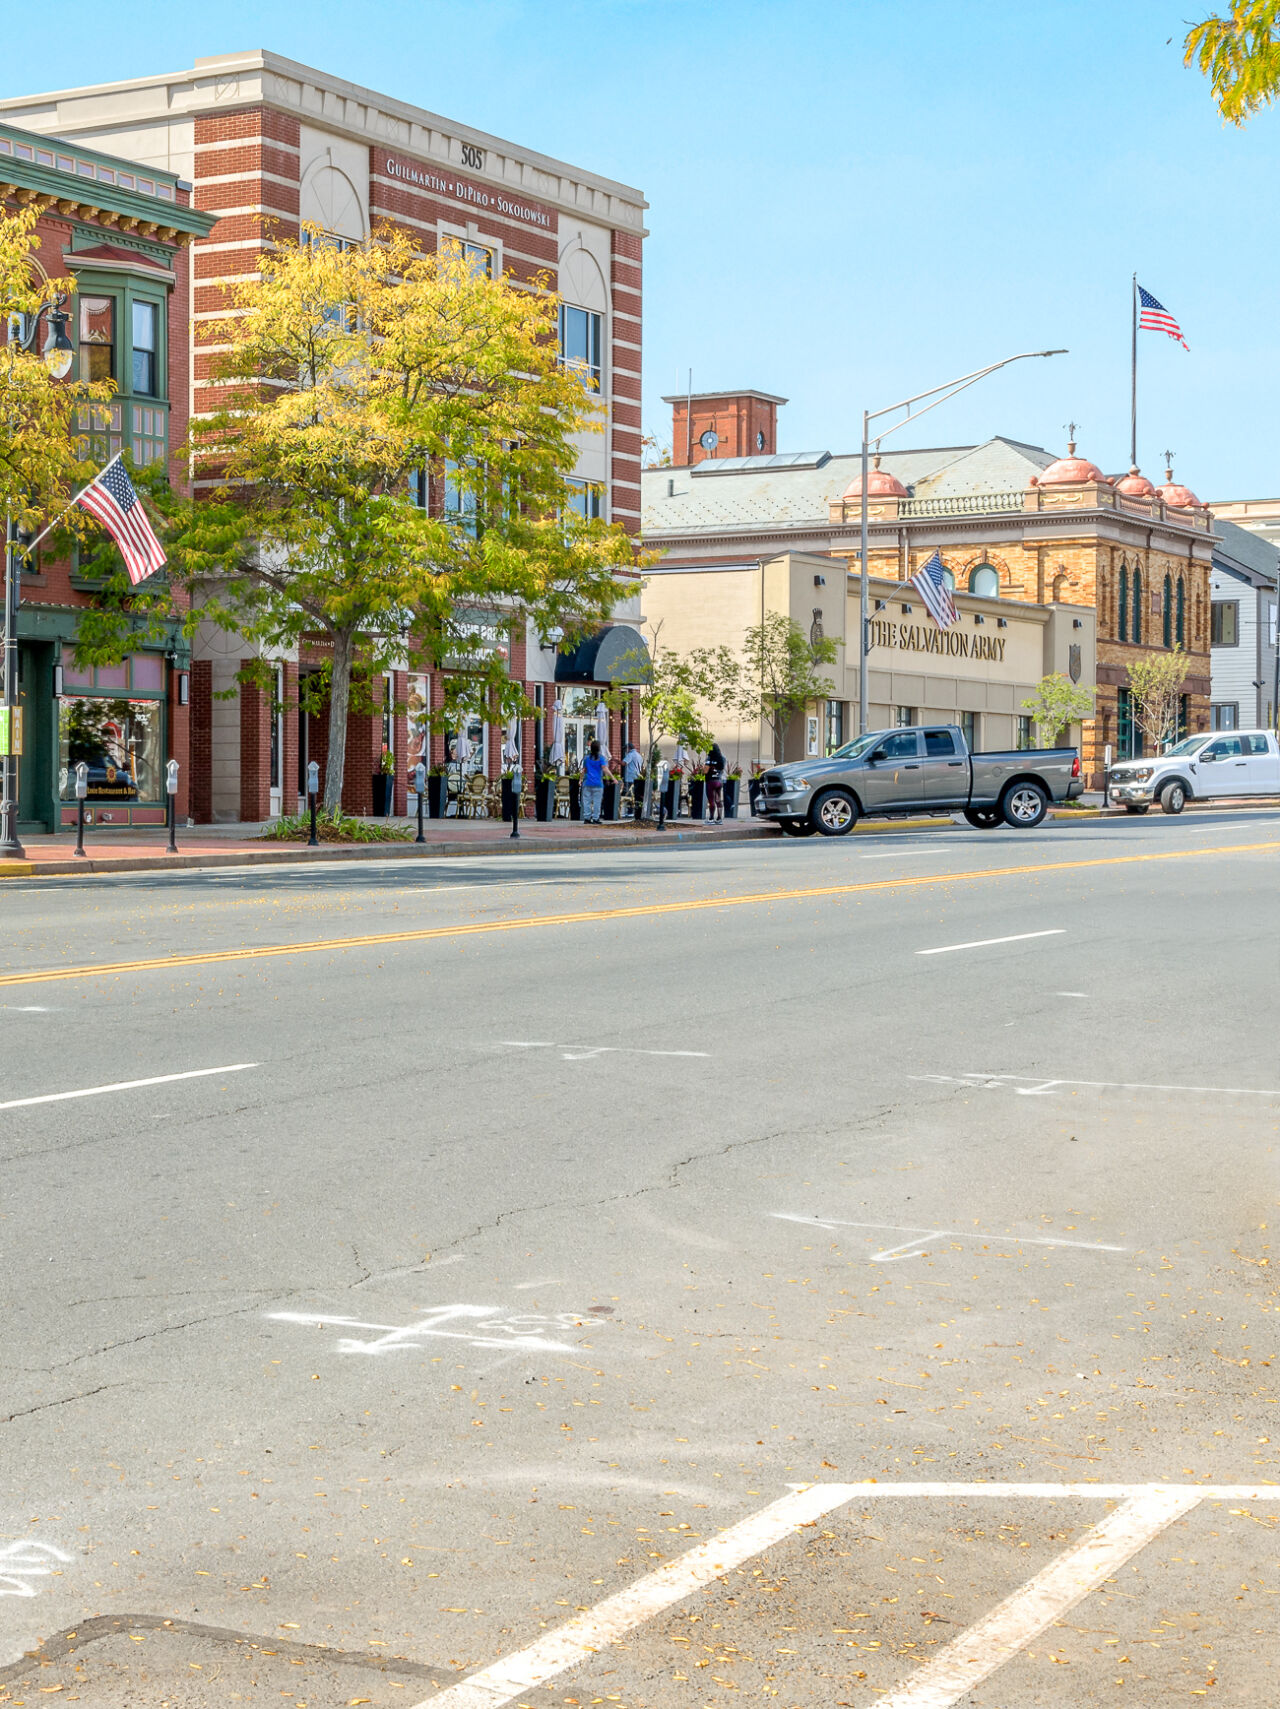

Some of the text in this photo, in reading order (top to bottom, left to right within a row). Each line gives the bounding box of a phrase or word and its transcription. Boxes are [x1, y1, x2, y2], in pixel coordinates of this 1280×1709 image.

[461, 144, 482, 170] 505
[869, 619, 1006, 662] THE SALVATION ARMY
